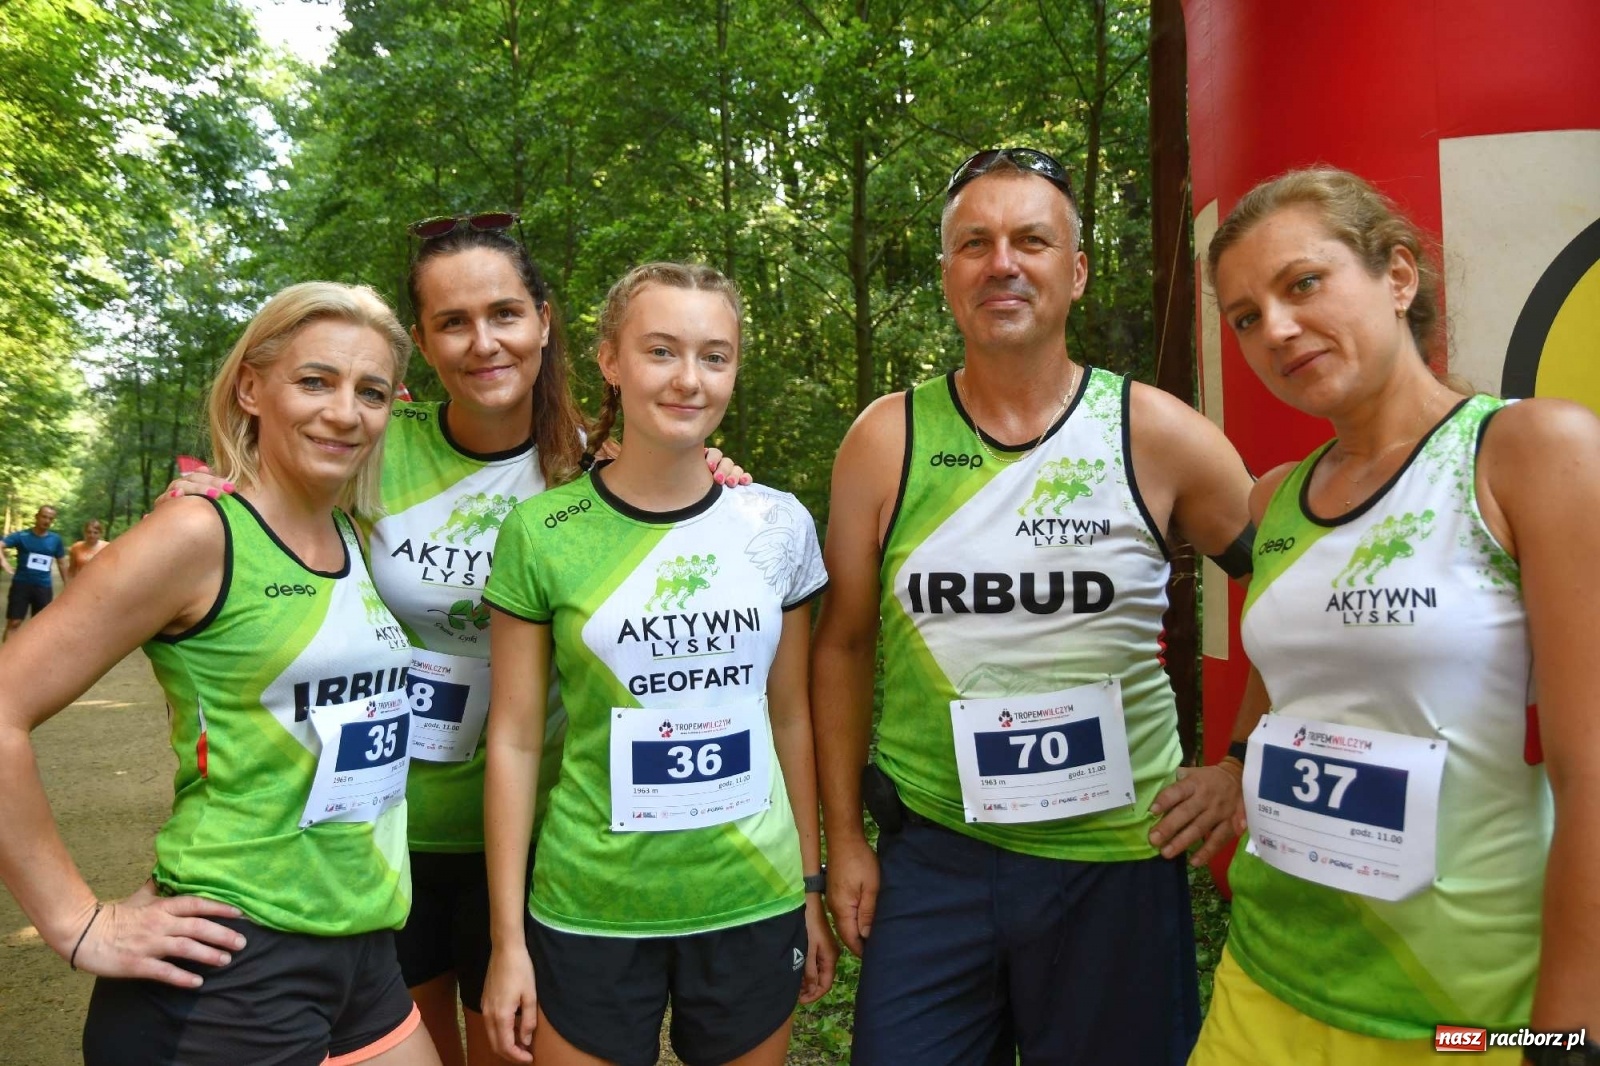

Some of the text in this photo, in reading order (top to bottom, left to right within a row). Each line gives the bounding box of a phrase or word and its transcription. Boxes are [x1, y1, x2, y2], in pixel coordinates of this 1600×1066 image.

[391, 408, 428, 421] eep
[930, 452, 983, 469] deep
[544, 498, 592, 528] deep
[1015, 519, 1110, 537] AKTYWNI
[1034, 535, 1093, 546] LYSKI
[1258, 536, 1295, 555] deep
[421, 566, 489, 587] LYS
[264, 583, 317, 598] deep
[908, 571, 1115, 614] IRBUD
[1325, 587, 1437, 612] AKTYWNI
[617, 608, 761, 644] AKTYWNI
[1343, 610, 1415, 625] LYSKI
[375, 625, 405, 641] AKTY
[388, 639, 409, 649] LYS
[651, 635, 736, 658] LYSKI
[628, 664, 754, 696] GEOFART
[408, 682, 435, 712] 8
[1014, 704, 1074, 720] TROPEMWILCZYM
[365, 721, 399, 762] 35
[1009, 731, 1069, 769] 70
[667, 743, 723, 779] 36
[1088, 765, 1106, 774] 11.00
[1292, 758, 1358, 810] 37
[1258, 803, 1273, 816] 1963
[1349, 826, 1403, 845] godz. 11.00
